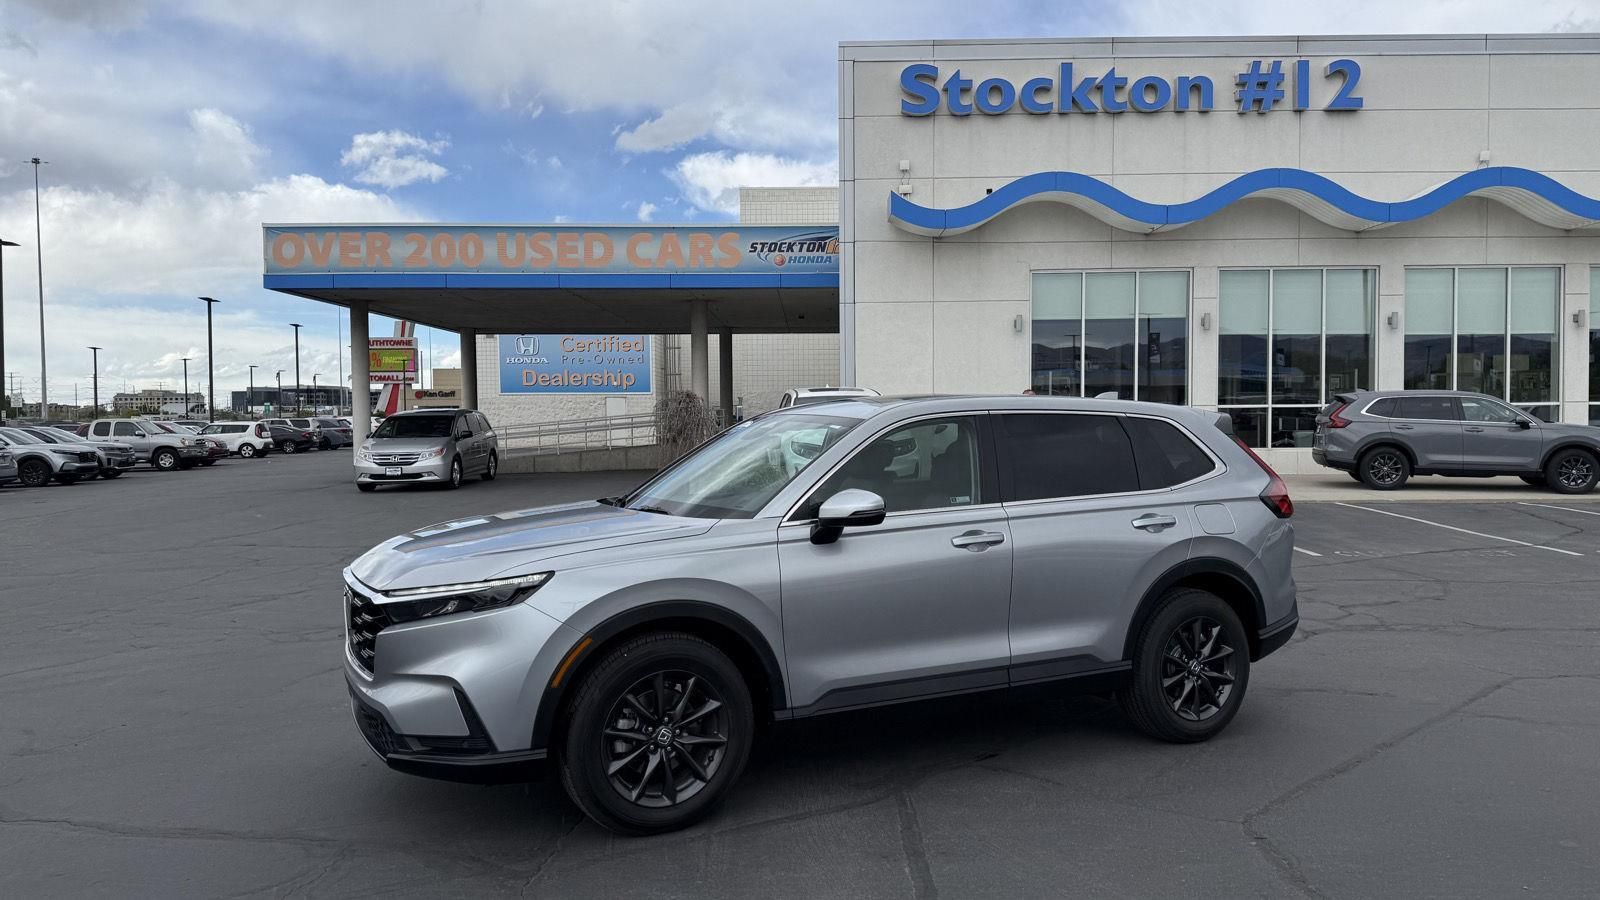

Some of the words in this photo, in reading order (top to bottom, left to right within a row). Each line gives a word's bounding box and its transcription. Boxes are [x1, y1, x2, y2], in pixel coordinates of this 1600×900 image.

[900, 62, 1215, 116] Stockton
[1236, 58, 1365, 113] #12
[272, 232, 392, 268] OVER
[403, 232, 484, 268] 200
[496, 232, 614, 268] USED
[626, 232, 742, 268] CARS
[749, 241, 828, 253] STOCKTON
[787, 255, 833, 264] HONDA
[560, 335, 645, 353] Certified
[506, 357, 549, 365] HONDA
[561, 354, 645, 365] Pre-Owned
[522, 368, 637, 391] Dealership
